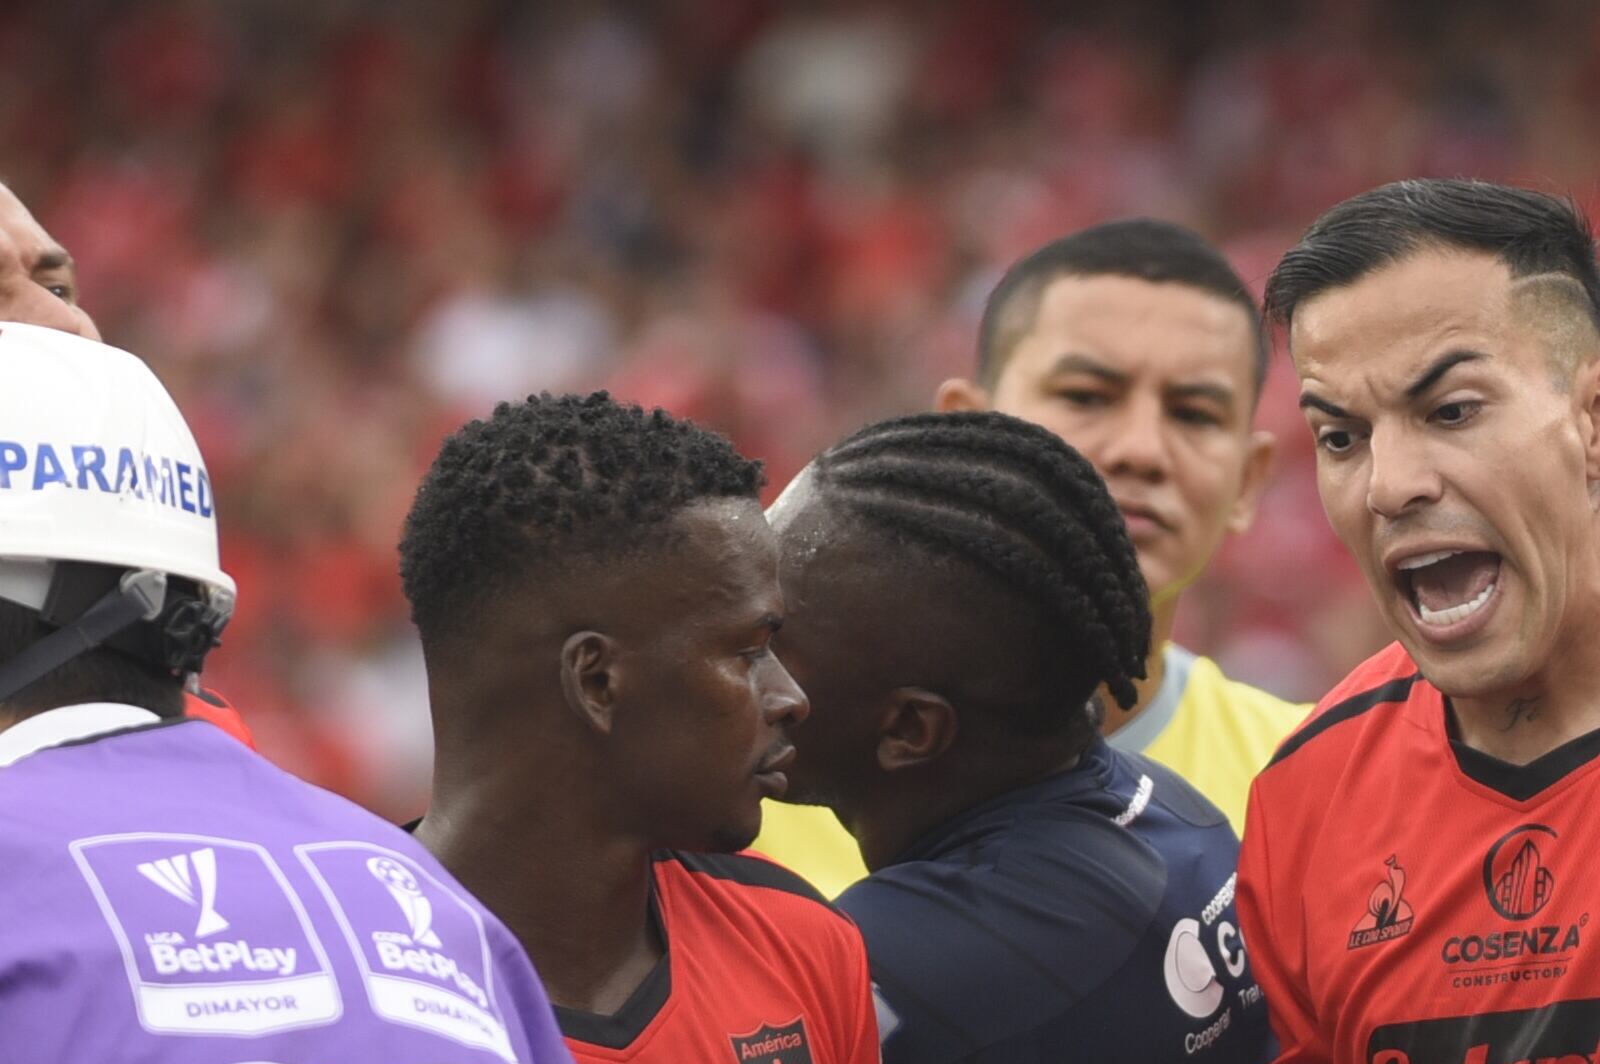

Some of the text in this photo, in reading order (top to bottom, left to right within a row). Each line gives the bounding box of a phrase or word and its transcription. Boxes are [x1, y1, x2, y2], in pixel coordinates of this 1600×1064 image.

[150, 940, 297, 975] BetPlay
[1442, 925, 1579, 964] COSENZA
[186, 995, 298, 1017] DIMAYOR
[741, 1030, 803, 1061] América
